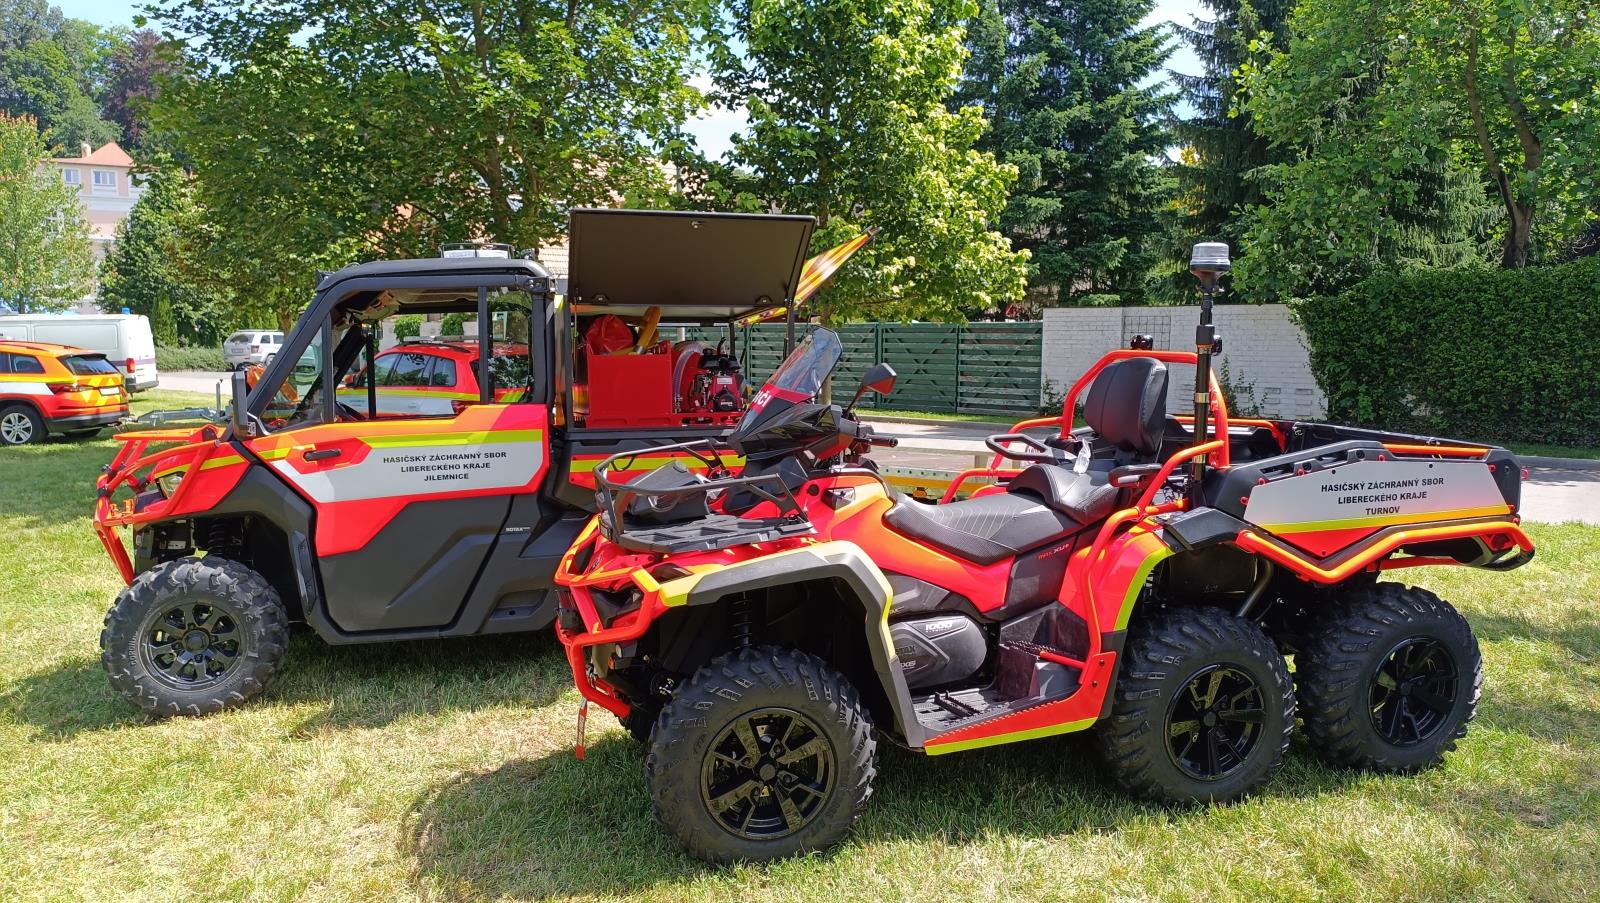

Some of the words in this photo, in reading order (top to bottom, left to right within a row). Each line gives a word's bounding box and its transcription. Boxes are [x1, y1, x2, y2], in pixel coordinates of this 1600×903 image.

[383, 454, 427, 463] HASIČSKÝ
[429, 451, 481, 462] ZÁCHRANNÝ
[484, 451, 507, 459] SBOR
[400, 463, 461, 473] LIBERECKÉHO
[463, 462, 491, 470] KRAJE
[424, 473, 470, 482] JILEMNICE
[1321, 482, 1366, 492] HASIČSKÝ
[1367, 479, 1420, 490] ZÁCHRANNÝ
[1421, 477, 1445, 486] SBOR
[1338, 493, 1398, 504] LIBERECKÉHO
[1400, 491, 1428, 500] KRAJE
[1365, 506, 1401, 515] TURNOV
[925, 620, 953, 631] 1000
